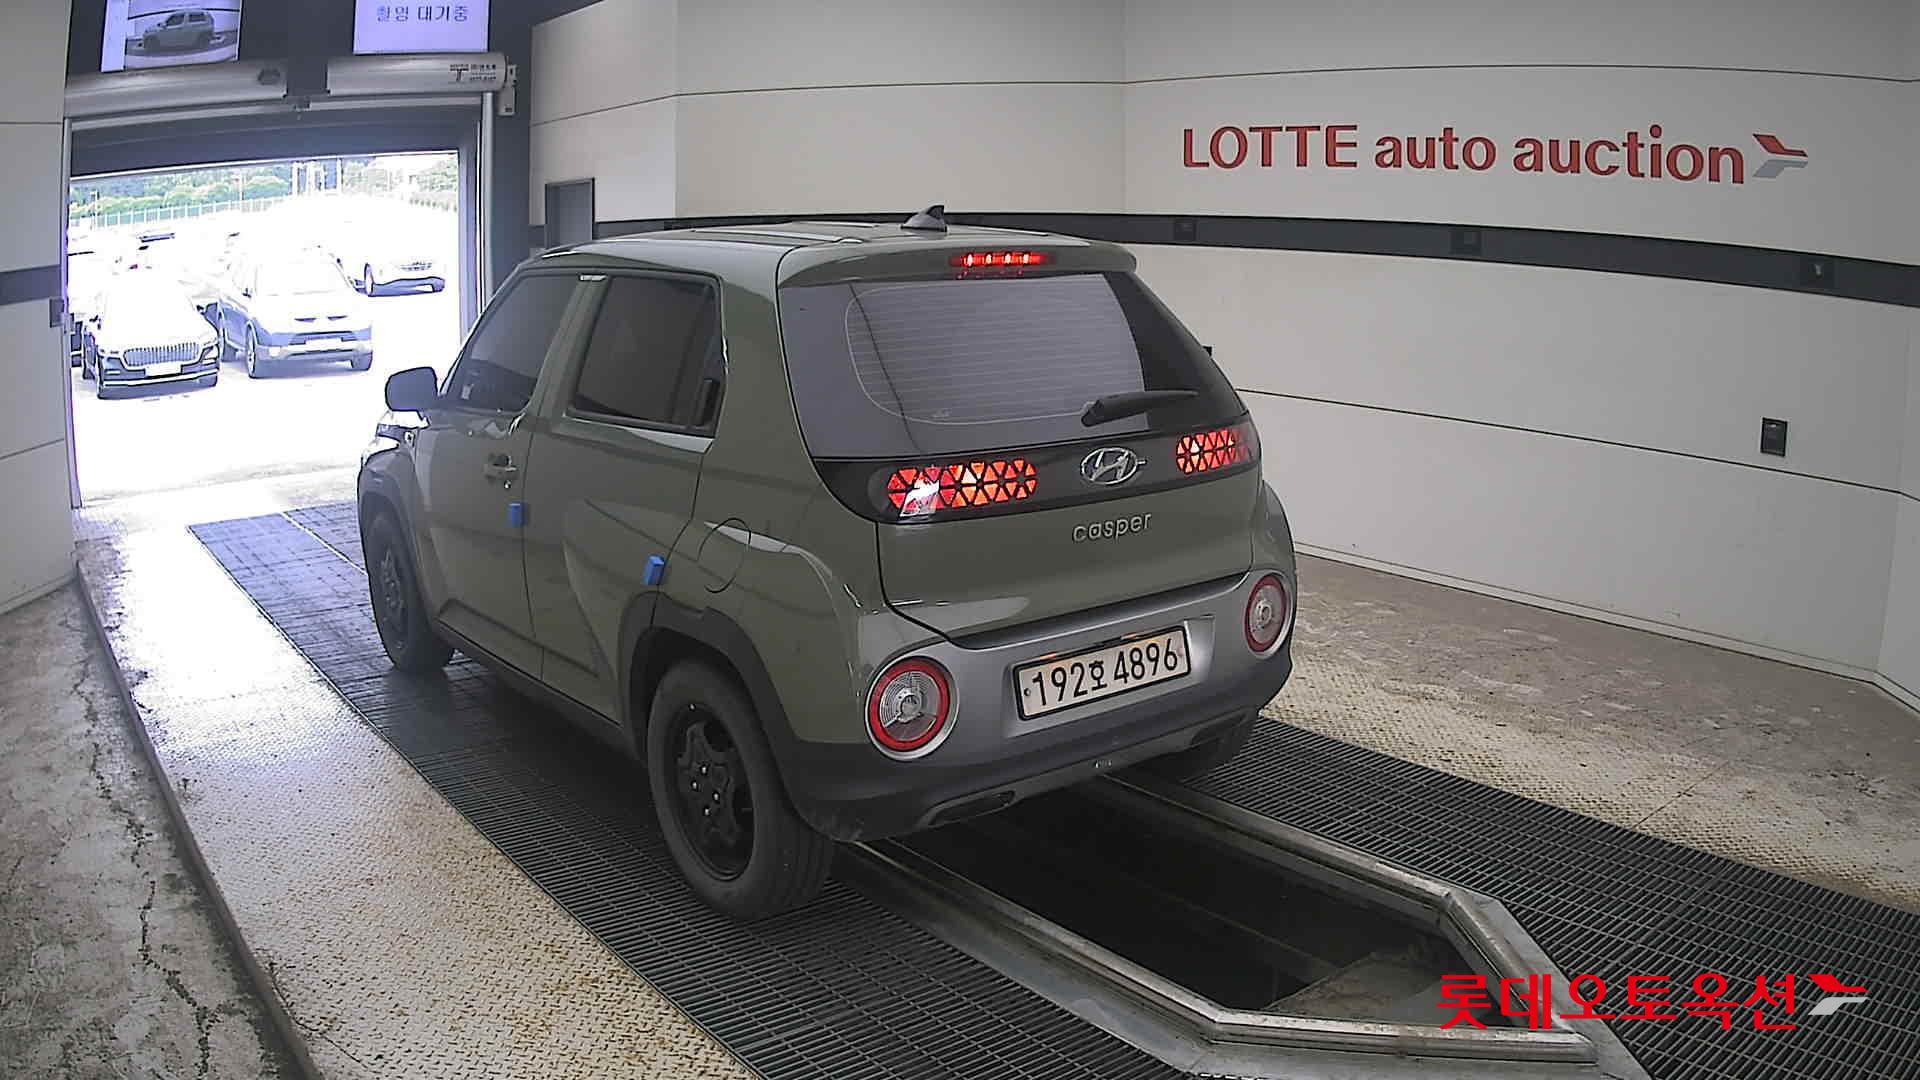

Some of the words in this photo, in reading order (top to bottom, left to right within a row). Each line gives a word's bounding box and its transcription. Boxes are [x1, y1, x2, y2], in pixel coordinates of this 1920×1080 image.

[417, 6, 469, 22] 대기중
[1183, 124, 1358, 169] LOTTE
[1374, 127, 1498, 171] auto
[1513, 124, 1745, 185] auction
[1072, 513, 1152, 543] casper
[1032, 660, 1108, 706] 192호
[1113, 638, 1178, 684] 4896
